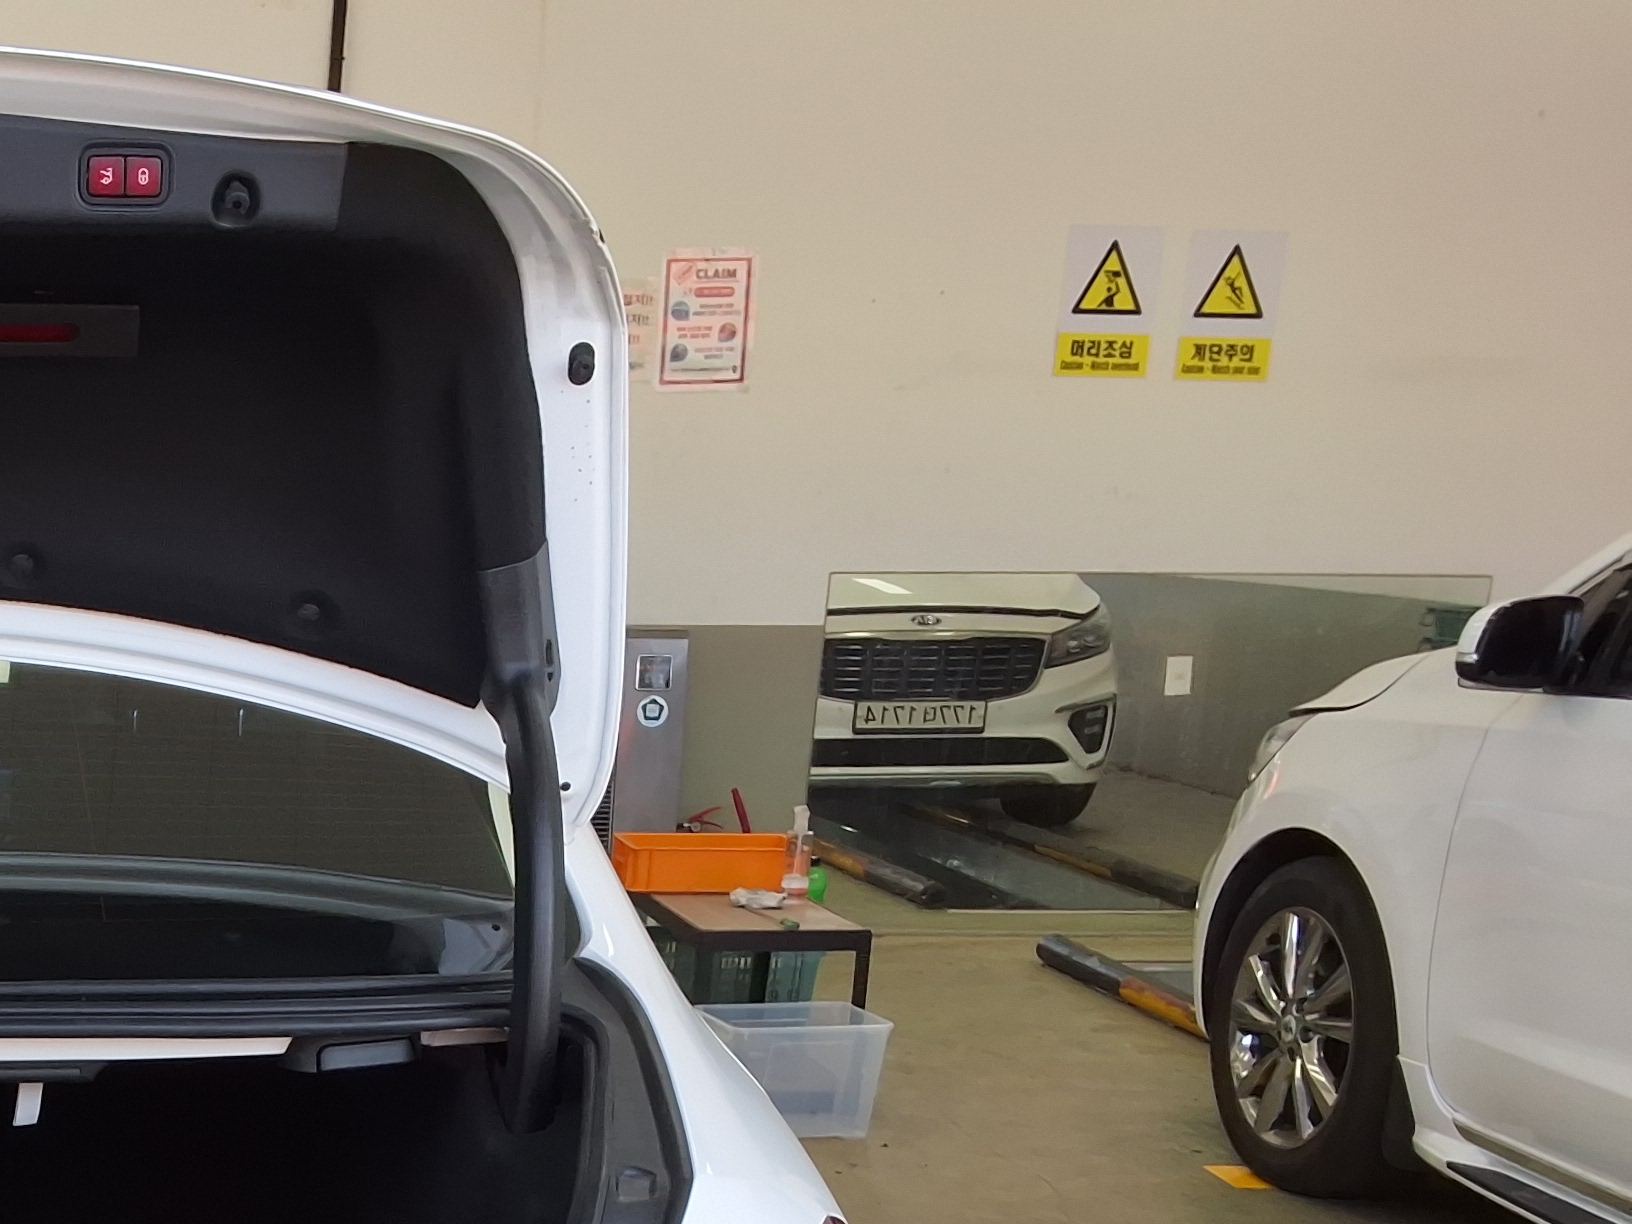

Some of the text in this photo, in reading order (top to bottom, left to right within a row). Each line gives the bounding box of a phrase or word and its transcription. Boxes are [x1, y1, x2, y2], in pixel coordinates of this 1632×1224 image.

[695, 268, 737, 279] CLAIM
[1070, 340, 1134, 359] 머리조심
[1190, 343, 1255, 362] 계단주의
